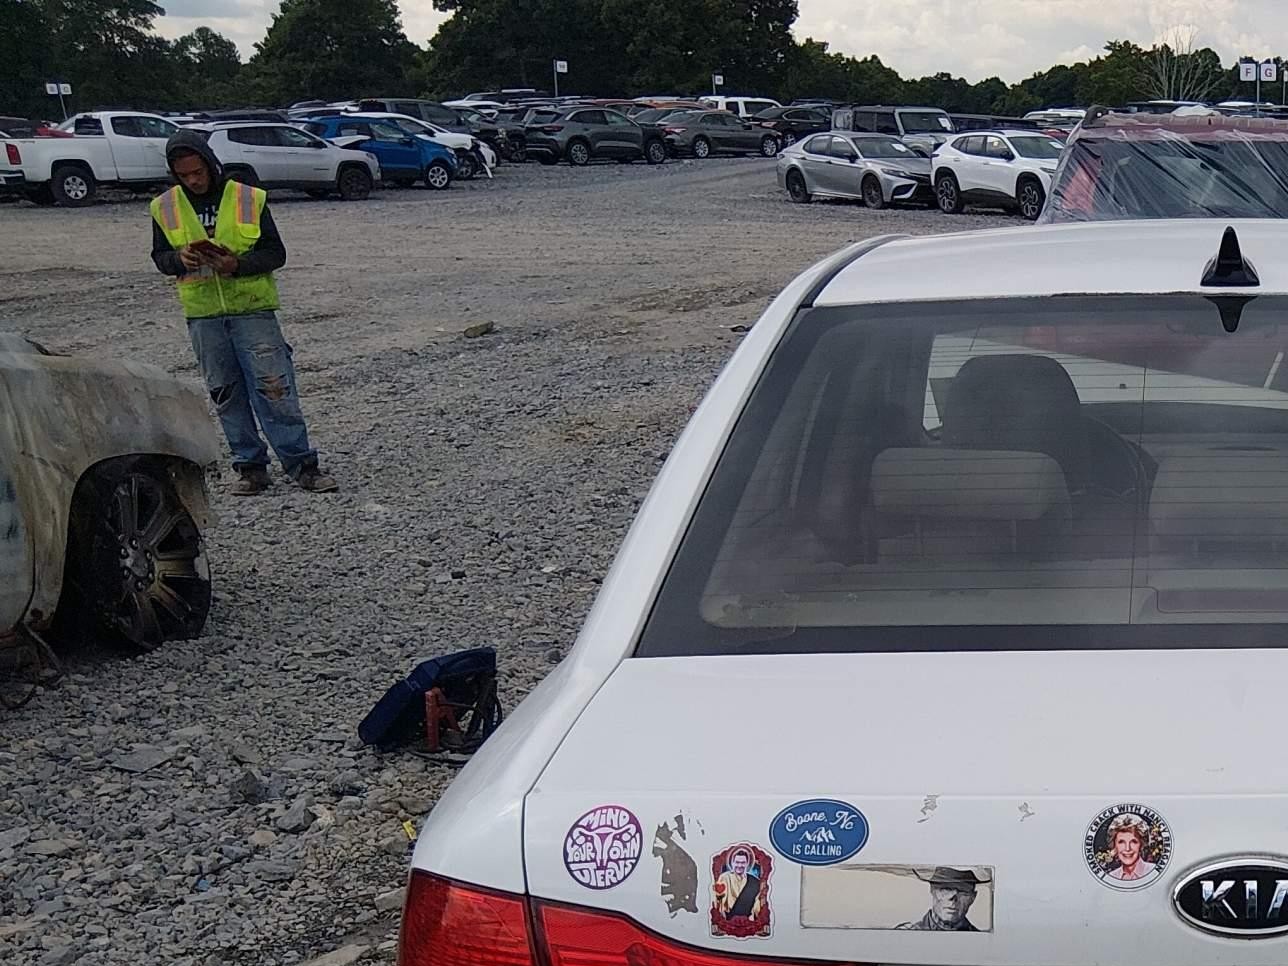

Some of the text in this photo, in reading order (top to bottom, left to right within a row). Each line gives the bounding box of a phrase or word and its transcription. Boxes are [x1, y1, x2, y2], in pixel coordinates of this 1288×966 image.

[1245, 68, 1251, 77] F
[1264, 68, 1272, 77] G
[1090, 807, 1115, 833] CRACK
[1117, 804, 1141, 814] WITH
[1144, 809, 1168, 833] NANCY
[784, 812, 828, 831] Boone,
[567, 832, 640, 862] YOUR OWN
[792, 844, 842, 856] IS CALLING
[1085, 835, 1102, 875] SMOKED
[1155, 837, 1171, 873] REAGAN
[569, 859, 636, 887] UTERUS
